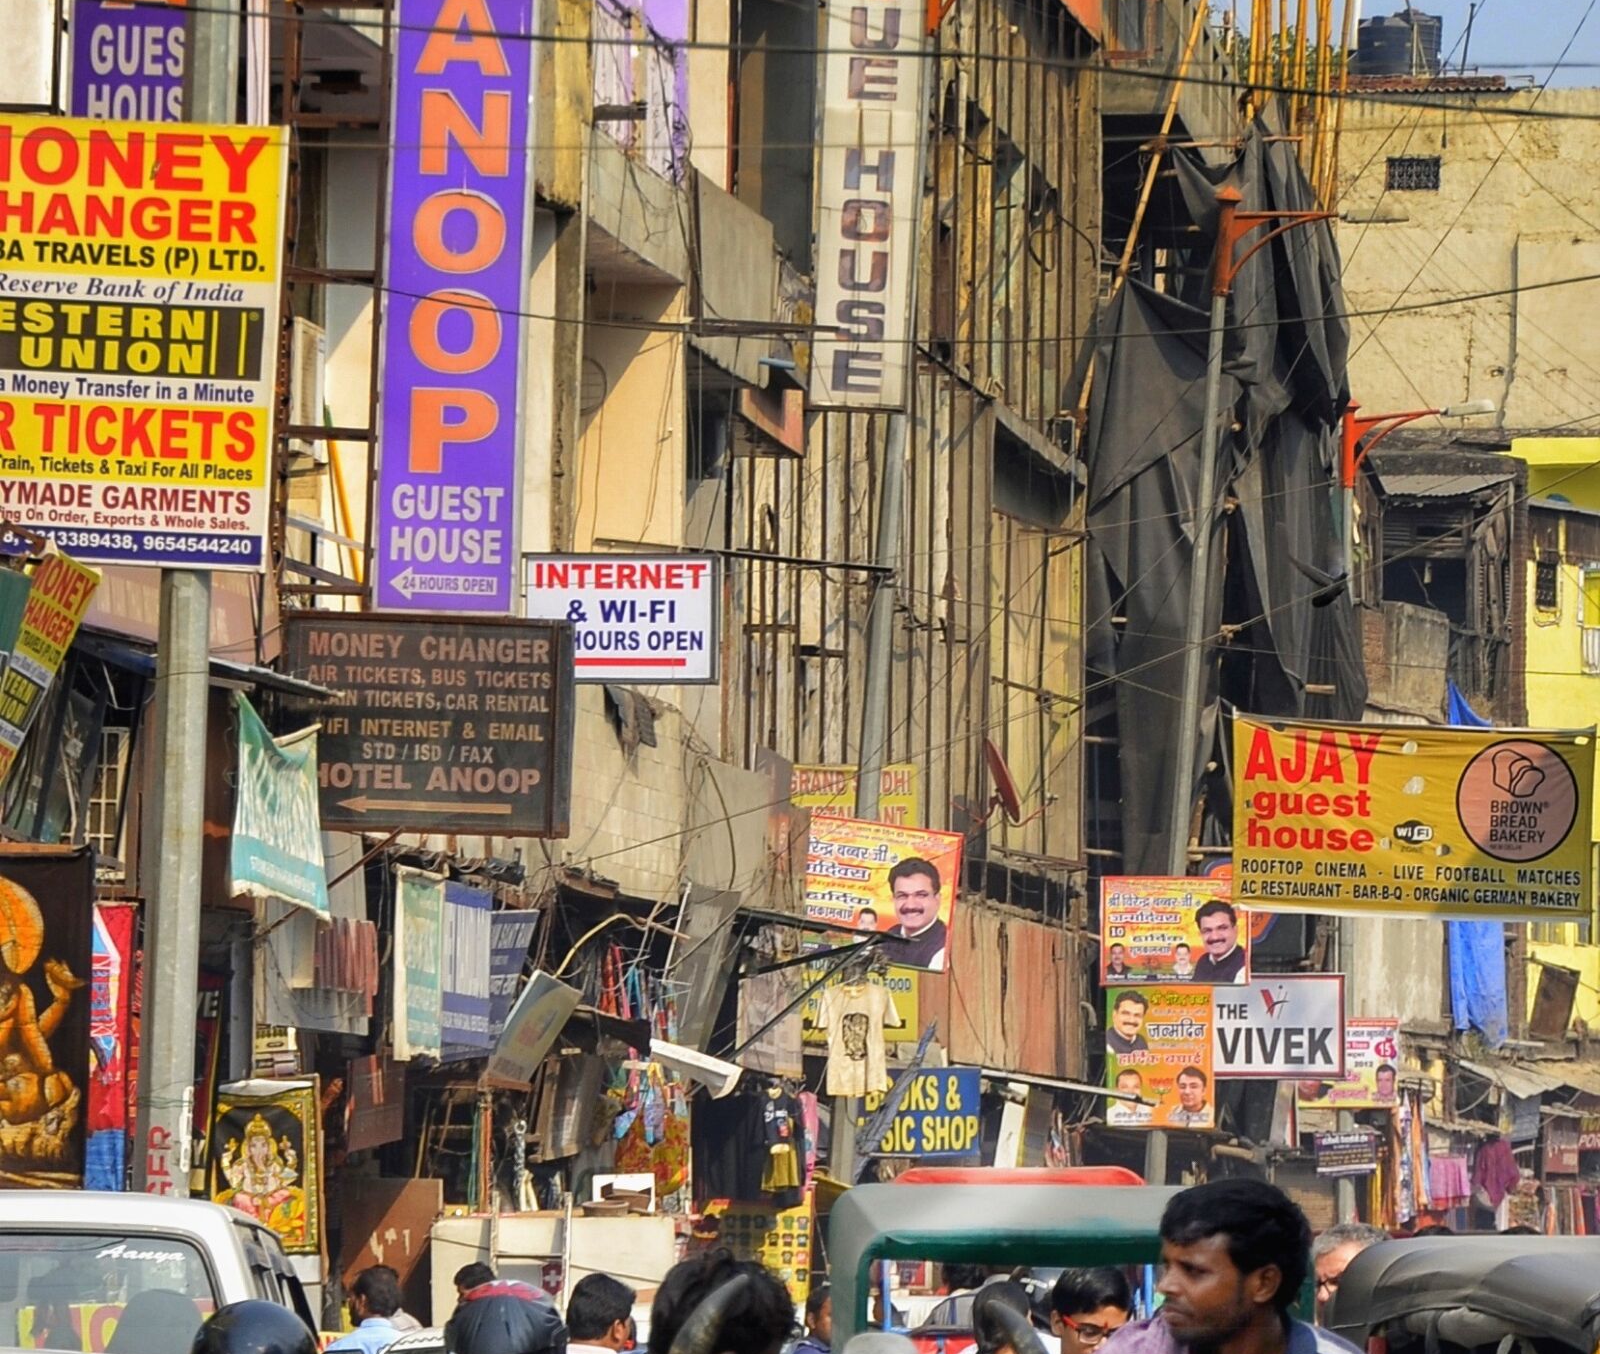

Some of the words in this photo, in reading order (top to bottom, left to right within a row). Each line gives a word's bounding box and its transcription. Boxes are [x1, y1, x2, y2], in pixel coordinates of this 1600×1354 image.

[33, 240, 156, 268] TRAVELS
[164, 246, 199, 276] (P)
[208, 248, 266, 273] LTD.
[831, 149, 897, 394] HOUSE
[86, 276, 146, 298] Bank
[153, 280, 181, 304] of
[183, 282, 244, 303] India
[20, 336, 204, 376] UNION
[11, 373, 70, 399] Money
[75, 377, 151, 400] Transfer
[155, 381, 172, 400] in
[177, 386, 188, 400] a
[194, 382, 255, 403] Minute
[33, 402, 256, 463] TICKETS
[40, 456, 94, 475] Tickets
[100, 458, 110, 475] &
[116, 460, 147, 477] Taxi
[152, 461, 175, 477] For
[179, 462, 199, 479] All
[204, 464, 253, 481] Places
[101, 485, 251, 515] GARMENTS
[392, 483, 504, 522] GUEST
[26, 507, 44, 521] On
[48, 509, 88, 526] Order,
[93, 512, 146, 528] Exports
[150, 515, 160, 527] &
[164, 515, 205, 529] Whole
[210, 517, 250, 531] Sales.
[143, 535, 251, 555] 9654544240
[390, 526, 502, 564] HOUSE
[402, 576, 415, 589] 24
[419, 577, 459, 590] HOURS
[463, 578, 494, 592] OPEN
[535, 563, 706, 589] INTERNET
[566, 599, 587, 623] &
[600, 599, 676, 623] WI-FI
[308, 631, 404, 659] MONEY
[419, 636, 550, 663] CHANGER
[574, 631, 640, 651] HOURS
[647, 631, 703, 651] OPEN
[308, 665, 337, 682] AIR
[346, 666, 426, 688] TICKETS,
[431, 669, 467, 686] BUS
[475, 671, 551, 689] TICKETS
[365, 690, 442, 711] TICKETS,
[446, 693, 479, 711] CAR
[485, 695, 550, 713] RENTAL
[360, 718, 452, 738] INTERNET
[462, 722, 475, 739] &
[488, 722, 544, 742] EMAIL
[363, 743, 396, 760] STD
[414, 744, 442, 761] ISD
[460, 746, 494, 764] FAX
[1244, 728, 1382, 785] AJAY
[425, 766, 541, 794] ANOOP
[1252, 788, 1372, 819] guest
[1491, 800, 1542, 813] BROWN
[1246, 818, 1374, 853] house
[1490, 815, 1538, 829] BREAD
[1490, 831, 1545, 843] BAKERY
[1241, 859, 1303, 875] ROOFTOP
[1315, 862, 1367, 878] CINEMA
[1394, 865, 1424, 880] LIVE
[1436, 866, 1505, 883] FOOTBALL
[1517, 869, 1581, 886] MATCHES
[1240, 880, 1257, 894] AC
[1261, 880, 1342, 897] RESTAURANT
[1353, 884, 1402, 901] BAR-B-Q
[1414, 887, 1469, 903] ORGANIC
[1474, 889, 1526, 905] GERMAN
[1531, 891, 1581, 906] BAKERY
[1216, 1003, 1249, 1020] THE
[1216, 1027, 1334, 1066] VIVEK
[946, 1075, 961, 1111] &
[922, 1116, 978, 1152] SHOP
[96, 1244, 186, 1262] Aanya
